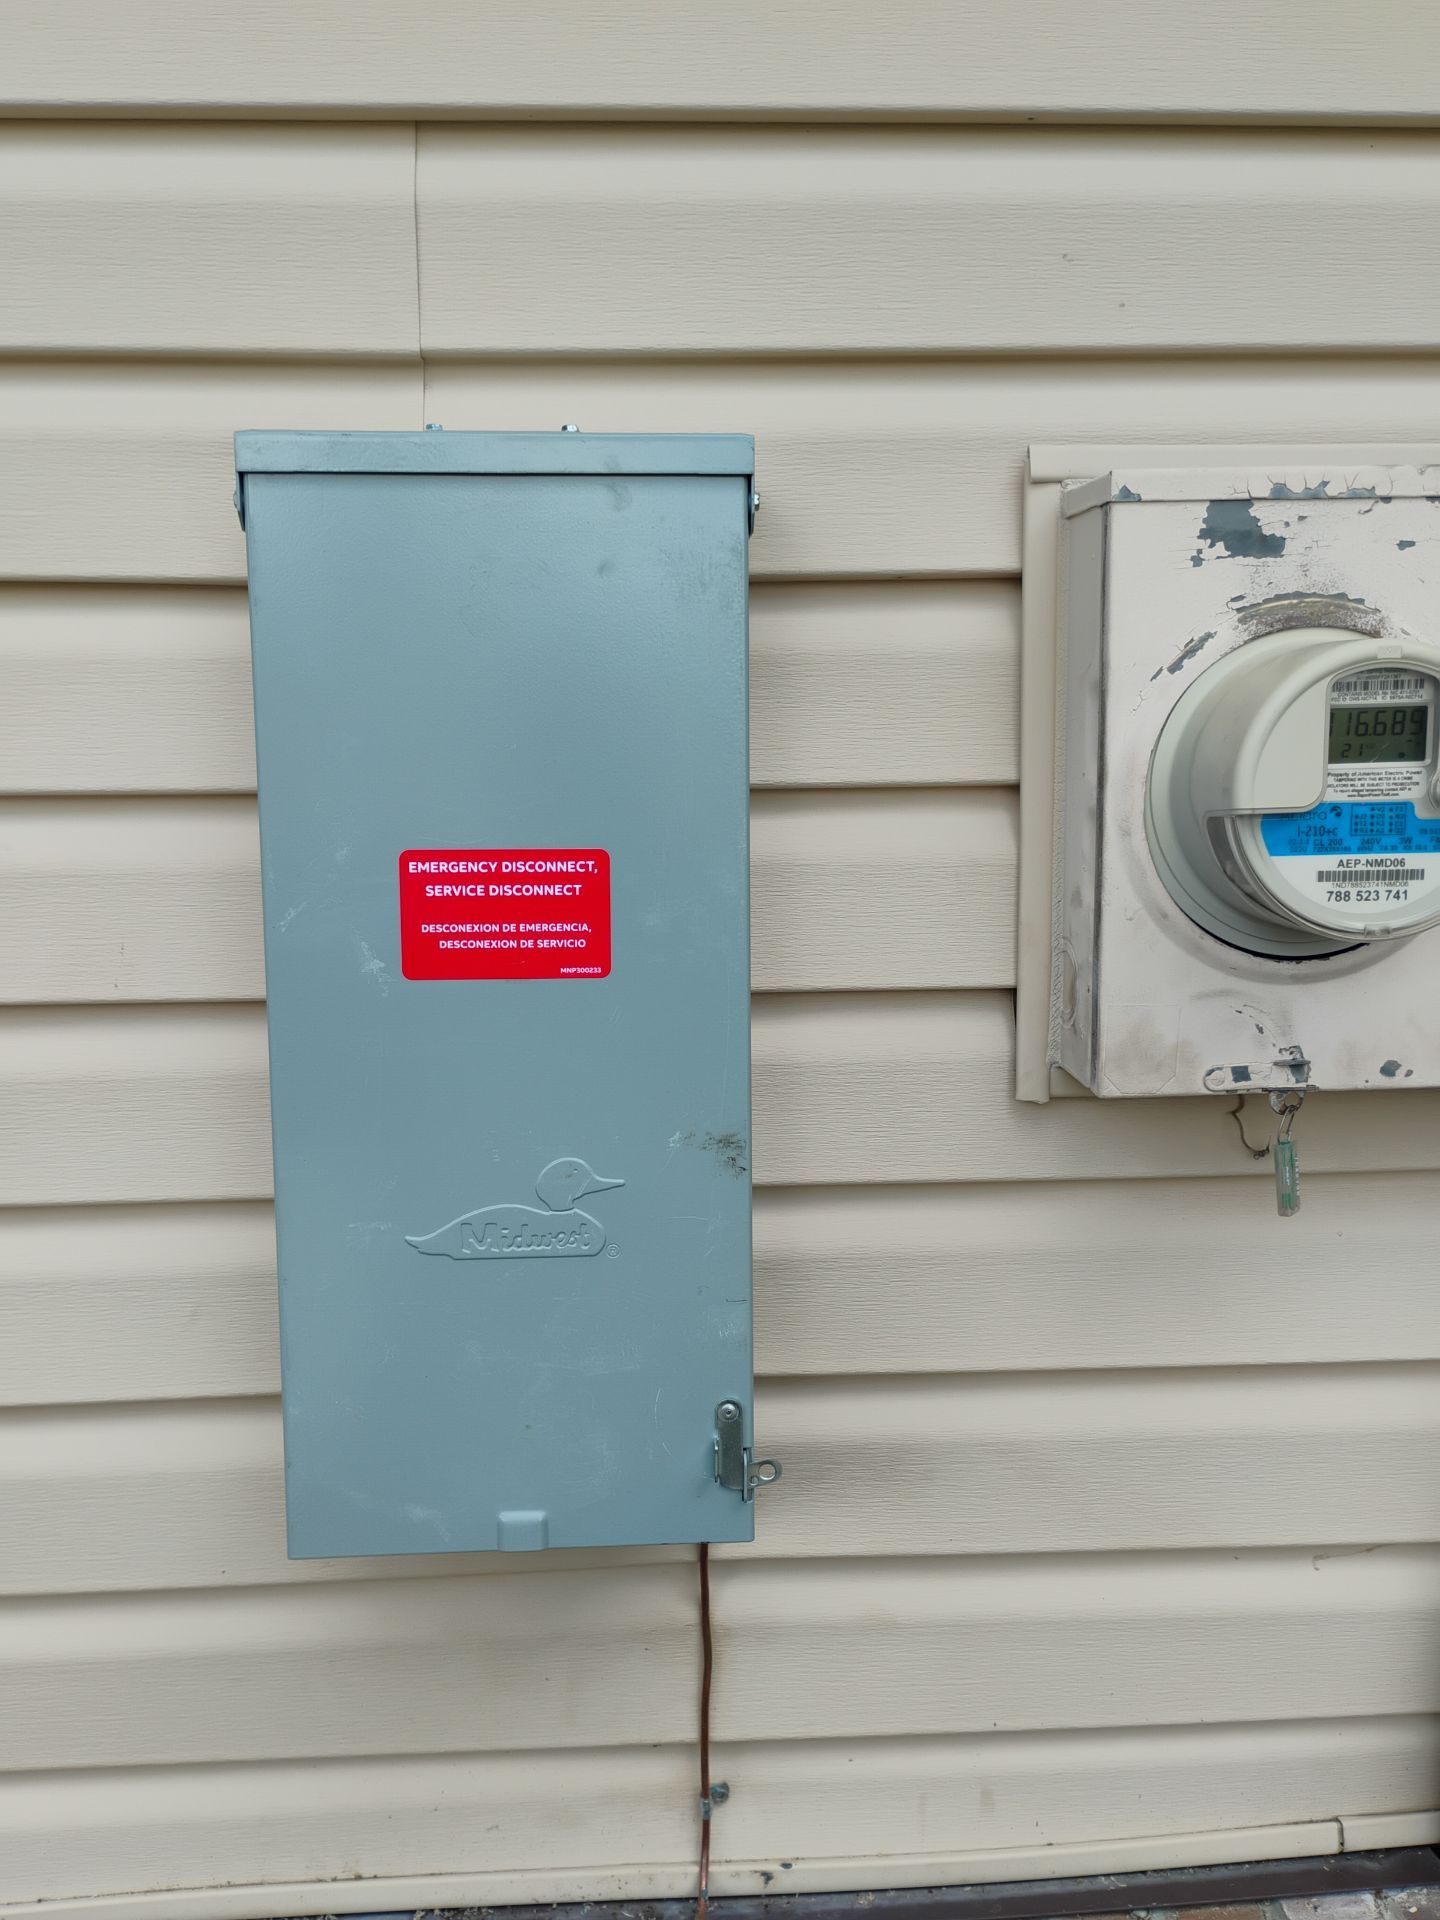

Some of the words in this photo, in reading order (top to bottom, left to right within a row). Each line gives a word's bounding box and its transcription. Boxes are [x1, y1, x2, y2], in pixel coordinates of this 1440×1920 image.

[408, 862, 498, 873] EMERGENCY
[501, 861, 598, 874] DISCONNECT,
[1337, 858, 1406, 868] AEP-NMD06
[425, 885, 485, 897] SERVICE
[489, 884, 582, 896] DISCONNECT
[1326, 890, 1351, 902] 788
[1356, 890, 1380, 902] 523
[1385, 889, 1408, 901] 741
[421, 924, 500, 933] DESCONEXION
[502, 924, 517, 932] DE
[519, 923, 592, 933] EMERGENCIA,
[439, 940, 517, 949] DESCONEXION
[520, 940, 534, 948] DE
[537, 939, 586, 948] SERVICIO
[460, 1223, 590, 1253] Midwest
